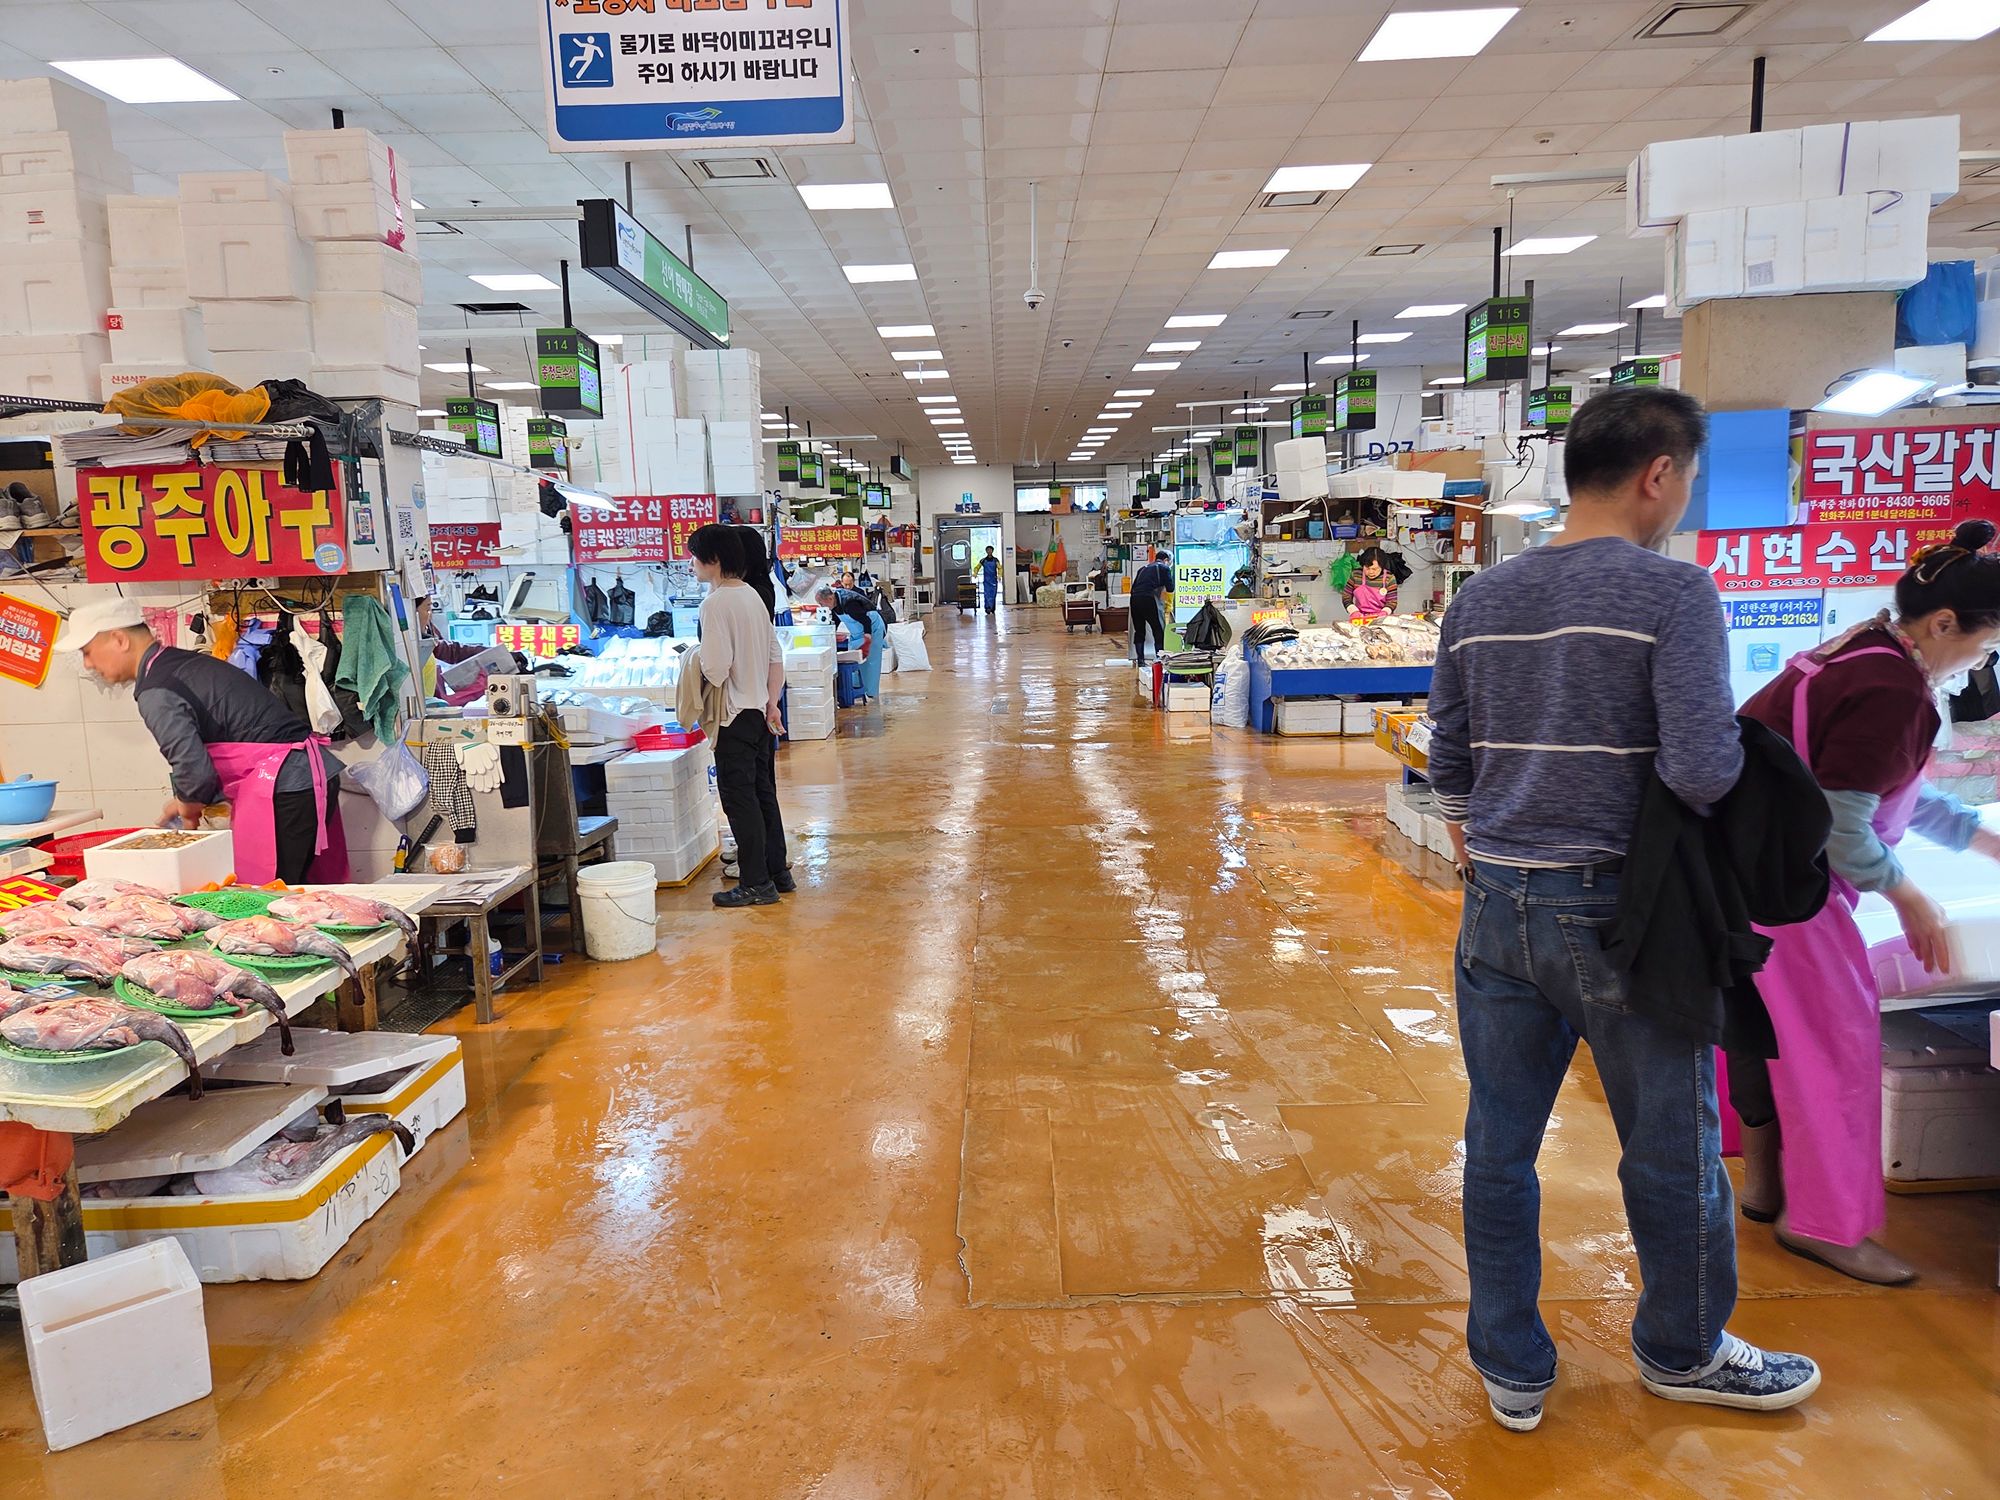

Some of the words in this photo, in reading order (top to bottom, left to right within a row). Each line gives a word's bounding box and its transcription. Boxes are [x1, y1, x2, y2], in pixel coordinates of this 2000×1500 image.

[620, 34, 675, 55] 물기로
[682, 28, 833, 53] 바닥이미끄러우니
[638, 62, 674, 84] 주의
[681, 61, 736, 82] 하시기
[743, 58, 818, 80] 바랍니다
[1498, 308, 1520, 319] 115
[545, 340, 568, 350] 114
[541, 365, 577, 381] 충청도수산
[1642, 365, 1659, 374] 129
[1354, 378, 1371, 387] 128
[1552, 392, 1567, 400] 142
[452, 405, 469, 413] 126
[670, 497, 713, 519] 충청도수산
[1809, 499, 1836, 510] 부재중
[1837, 499, 1856, 509] 전화
[1857, 495, 1951, 508] 010-8430-9605
[88, 469, 333, 569] 광주아구
[1819, 510, 1865, 521] 전화주시면
[597, 528, 615, 547] 국산
[782, 530, 799, 542] 국산
[800, 530, 816, 542] 생물
[817, 529, 841, 542] 참홍어
[842, 529, 858, 541] 전문
[1708, 528, 1909, 576] 서현수산
[1179, 568, 1222, 582] 나주상회
[1725, 580, 1763, 589] 010
[1769, 577, 1820, 587] 8430
[1828, 575, 1878, 585] 9605
[1738, 601, 1818, 614] 신한은행(서지수)
[1734, 613, 1819, 626] 110-279-921634
[498, 626, 578, 642] 냉동새우
